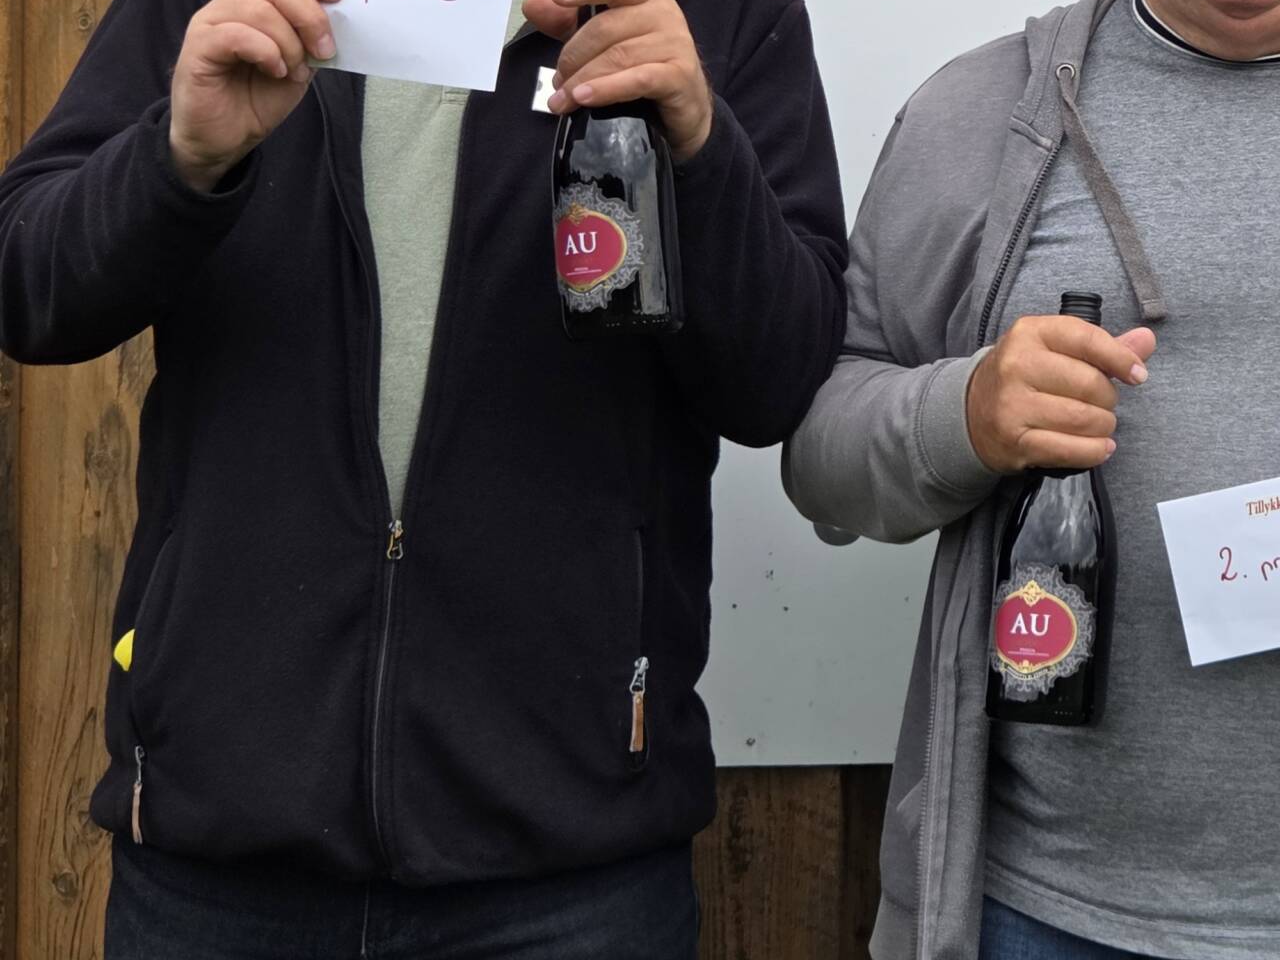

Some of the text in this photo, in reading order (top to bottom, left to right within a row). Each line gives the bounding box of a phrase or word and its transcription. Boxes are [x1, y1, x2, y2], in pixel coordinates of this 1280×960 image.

[565, 231, 598, 256] AU
[1219, 546, 1248, 582] 2.
[1010, 612, 1051, 636] AU
